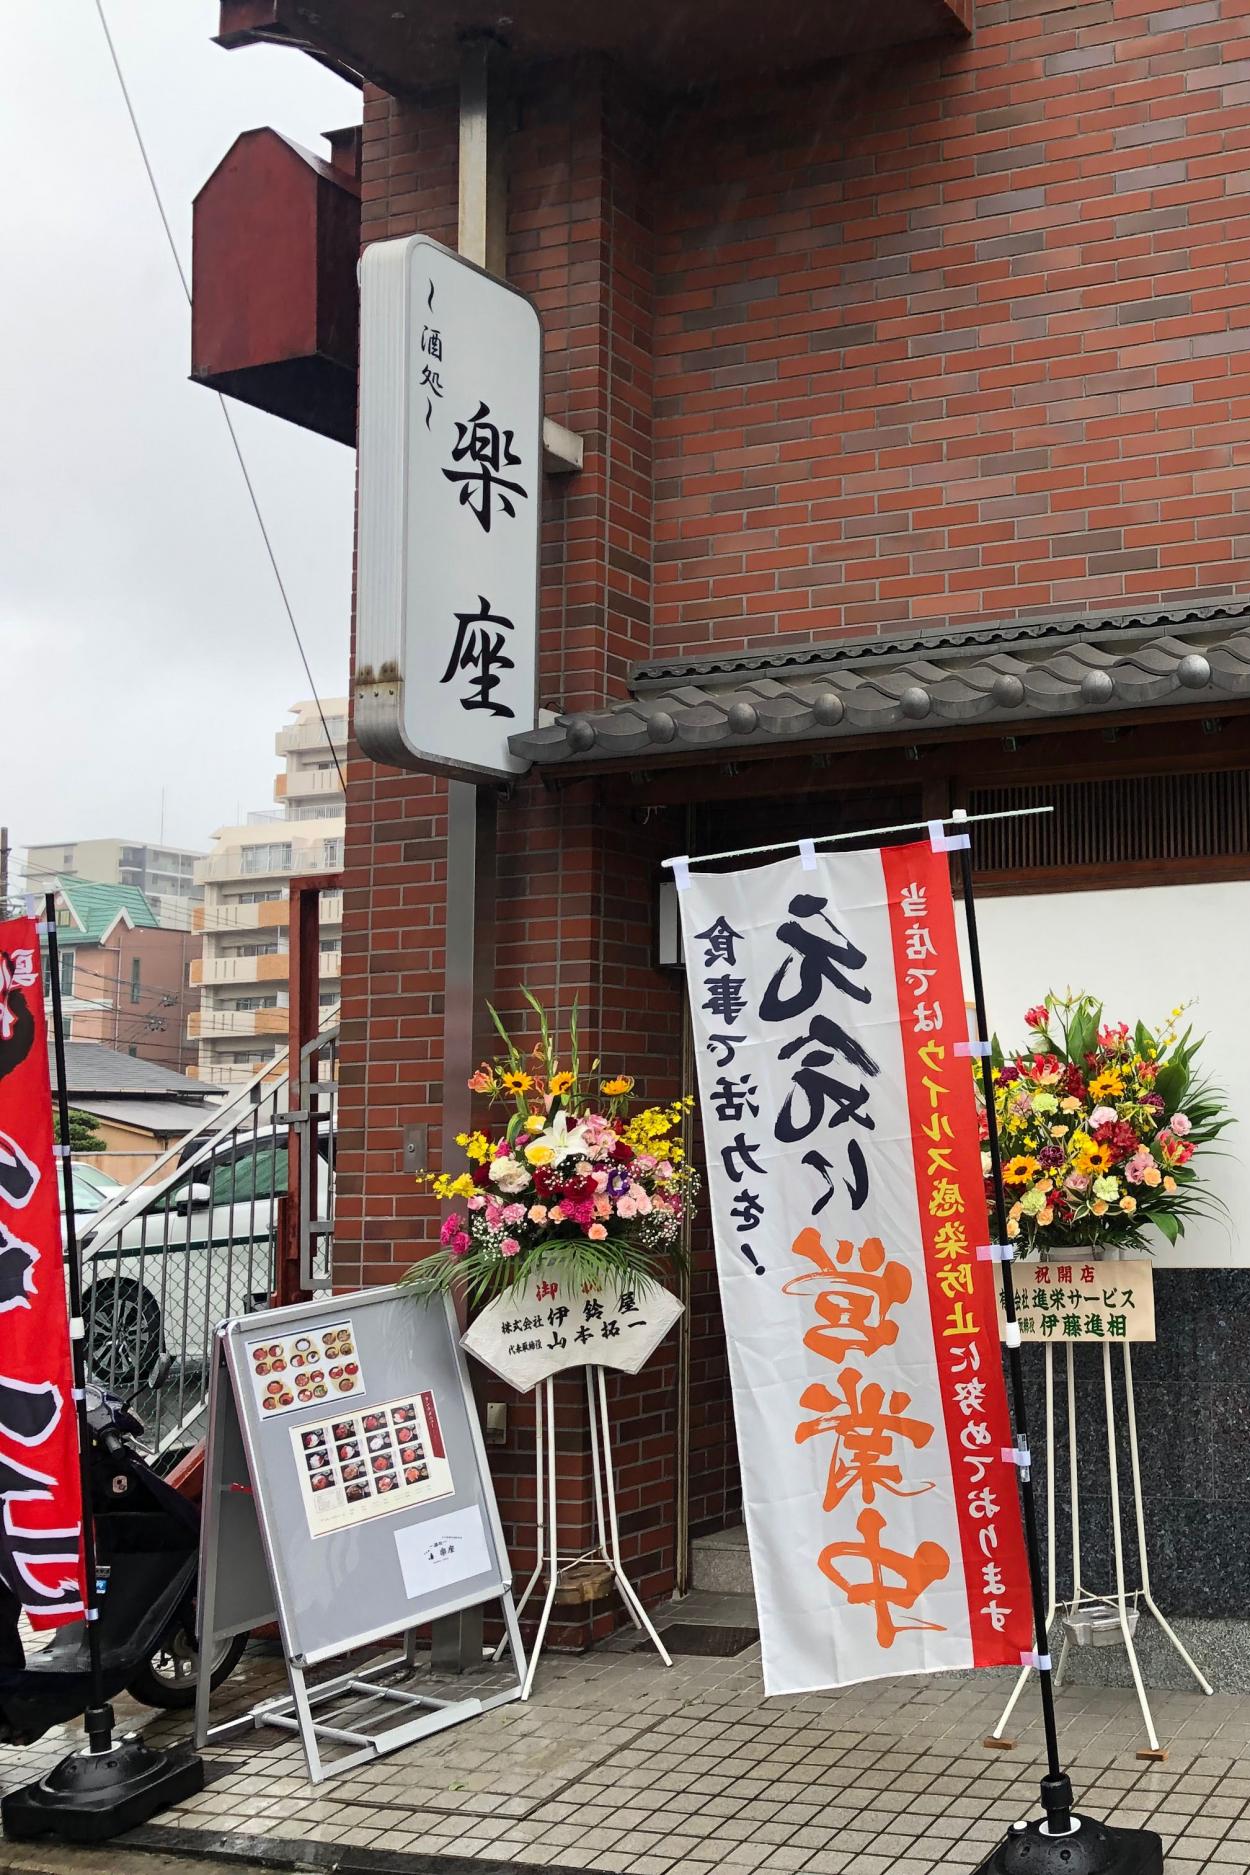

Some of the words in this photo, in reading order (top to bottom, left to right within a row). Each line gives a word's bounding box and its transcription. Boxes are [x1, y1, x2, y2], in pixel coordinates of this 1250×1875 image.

[440, 401, 528, 719] 楽座
[1034, 1265, 1096, 1284] 祝開店
